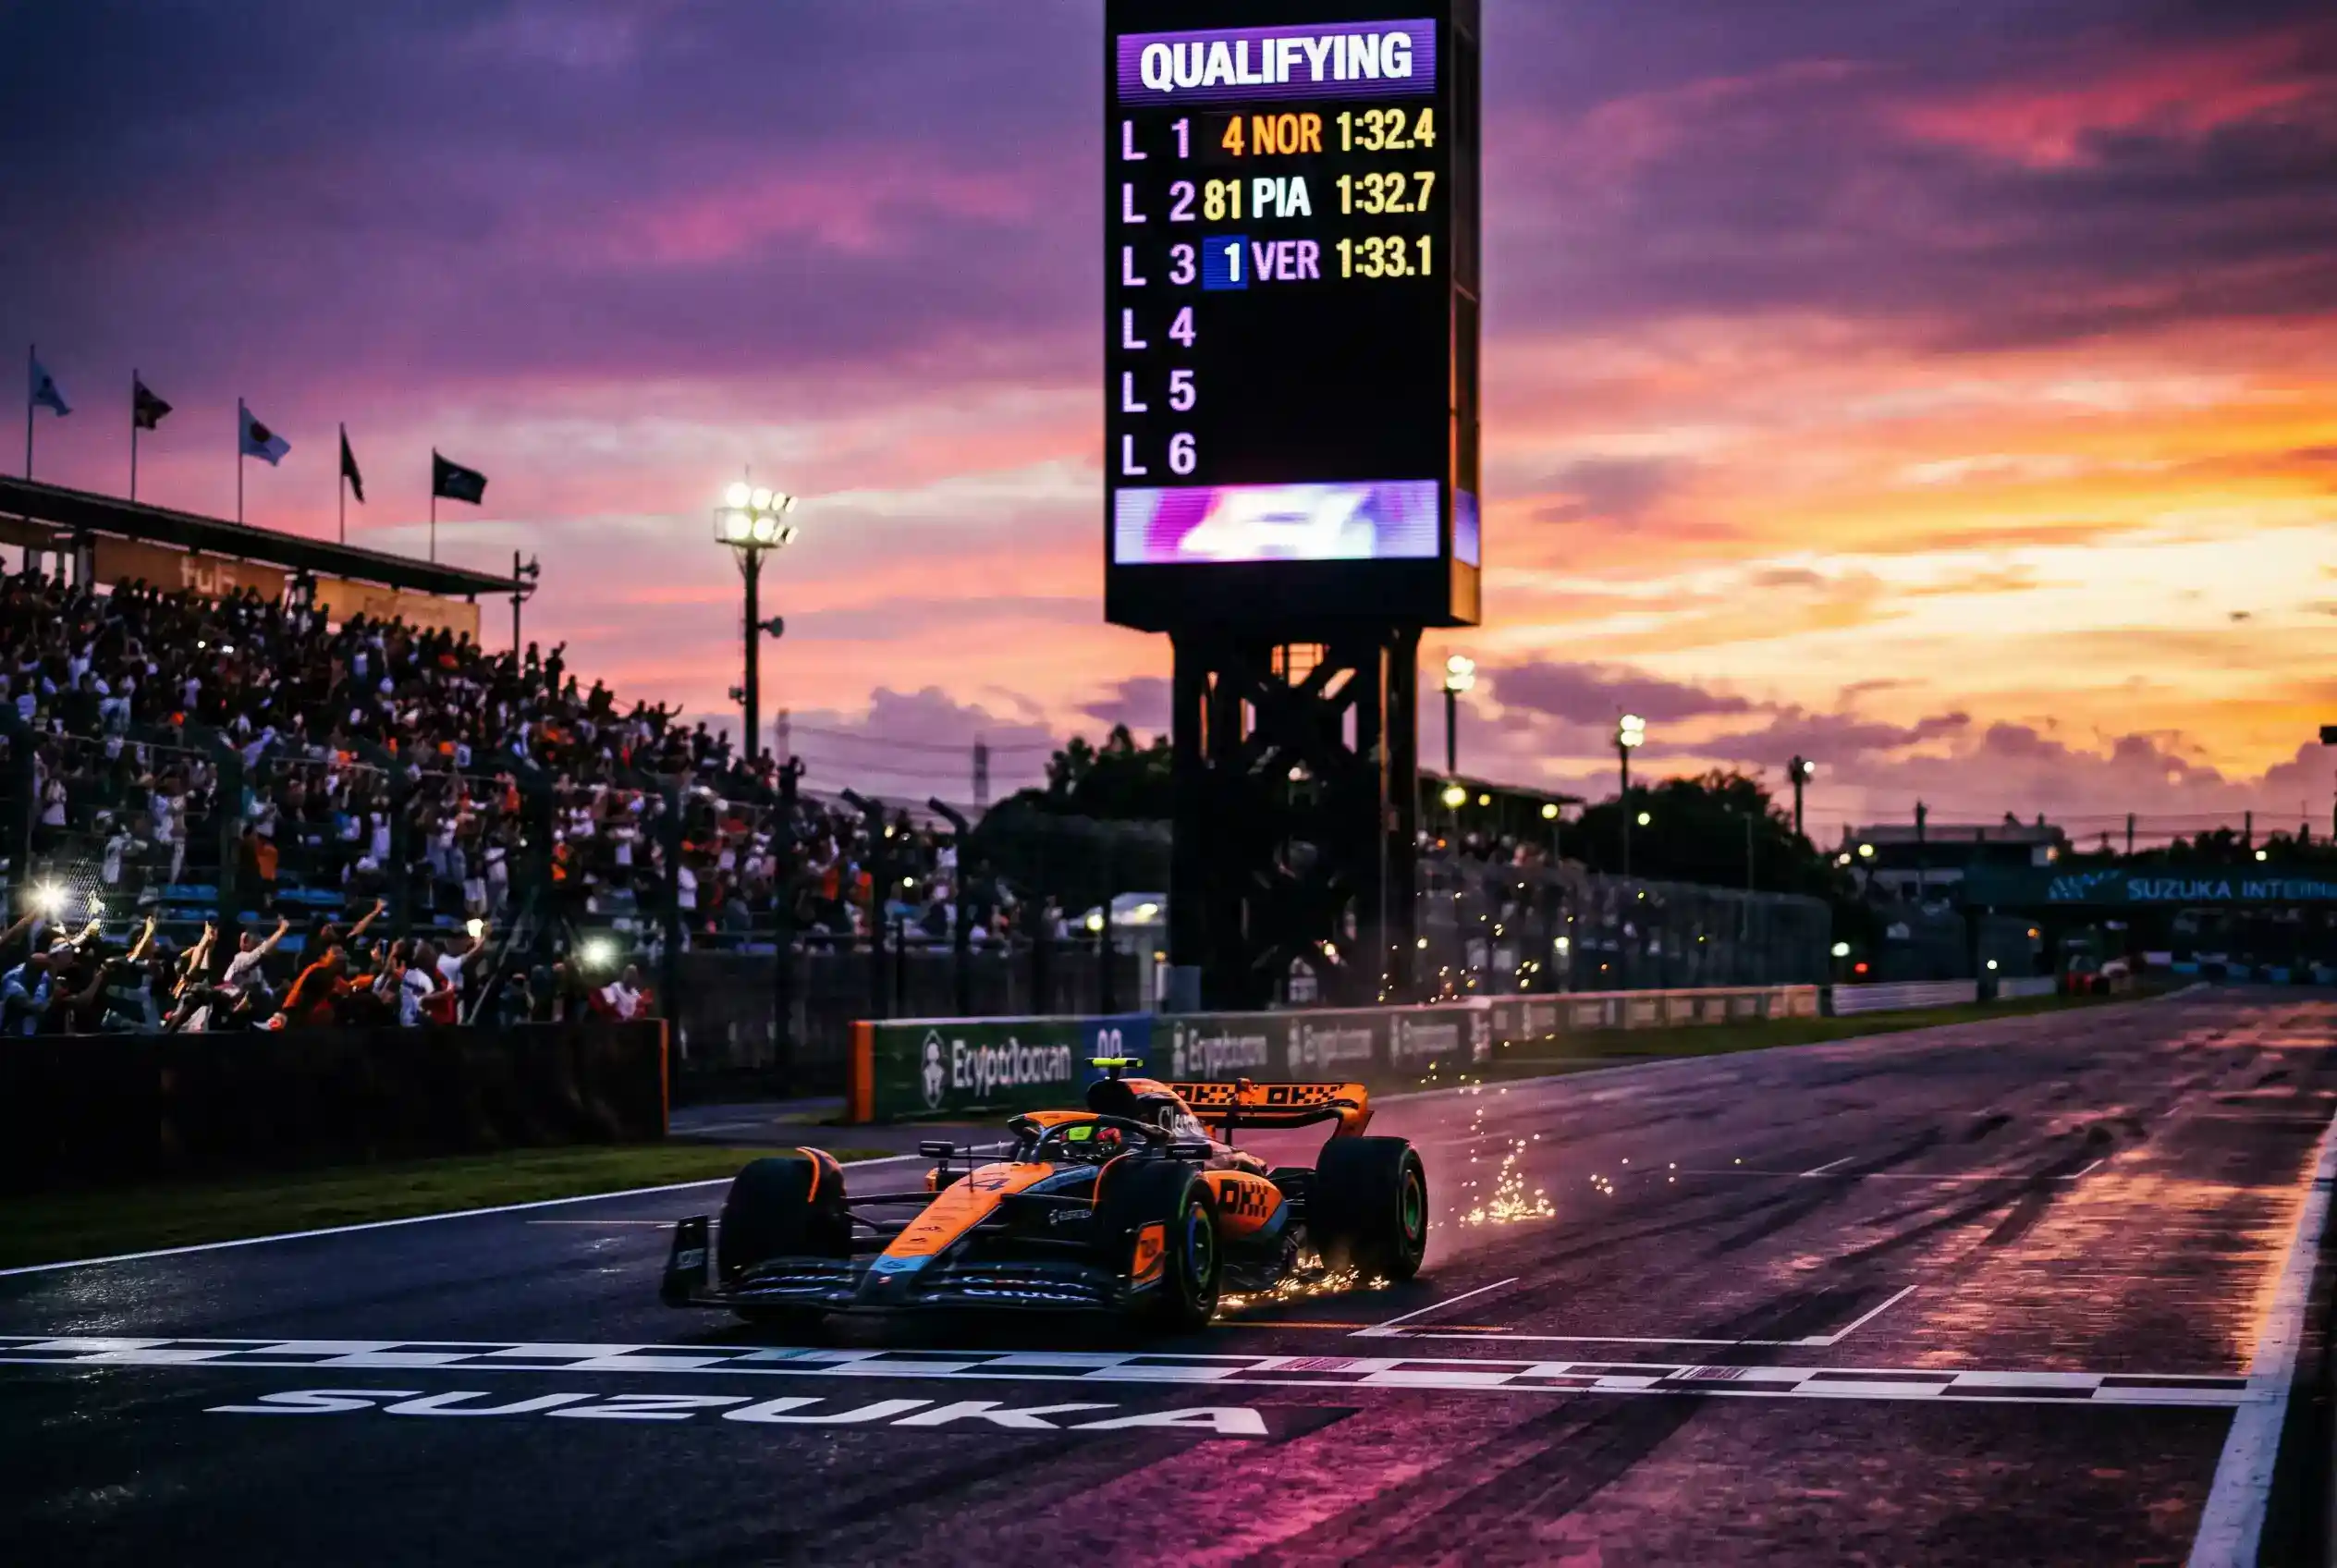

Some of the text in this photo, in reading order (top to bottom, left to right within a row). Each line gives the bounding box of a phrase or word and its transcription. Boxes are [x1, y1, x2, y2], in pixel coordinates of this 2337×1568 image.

[1139, 31, 1413, 92] QUALIFYING
[1122, 108, 1436, 160] L 1 4 NOR 1:32.4
[1123, 171, 1435, 223] L 2 81 PIA 1:32.7
[1123, 235, 1430, 286] L 3 1 VER 1:33.1
[1123, 307, 1196, 349] L 4
[1122, 370, 1195, 412] L 5
[1122, 433, 1196, 475] L 6
[2126, 878, 2232, 900] SUZUKA
[203, 1390, 1269, 1435] SUZUKA
